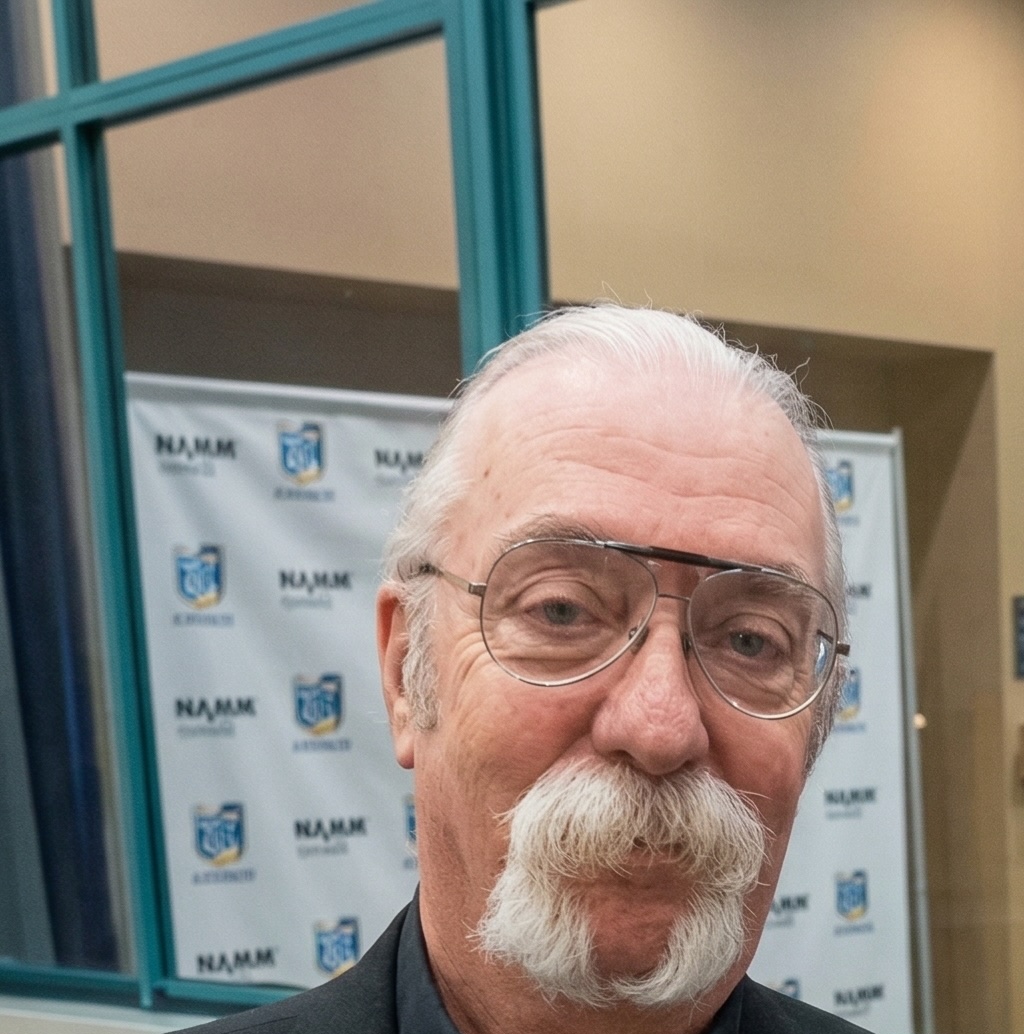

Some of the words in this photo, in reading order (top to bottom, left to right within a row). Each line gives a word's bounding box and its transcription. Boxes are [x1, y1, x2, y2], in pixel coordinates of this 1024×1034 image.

[374, 449, 424, 472] NAM
[176, 696, 256, 721] NAMM
[294, 817, 367, 840] NAMM
[197, 949, 276, 974] NAMM
